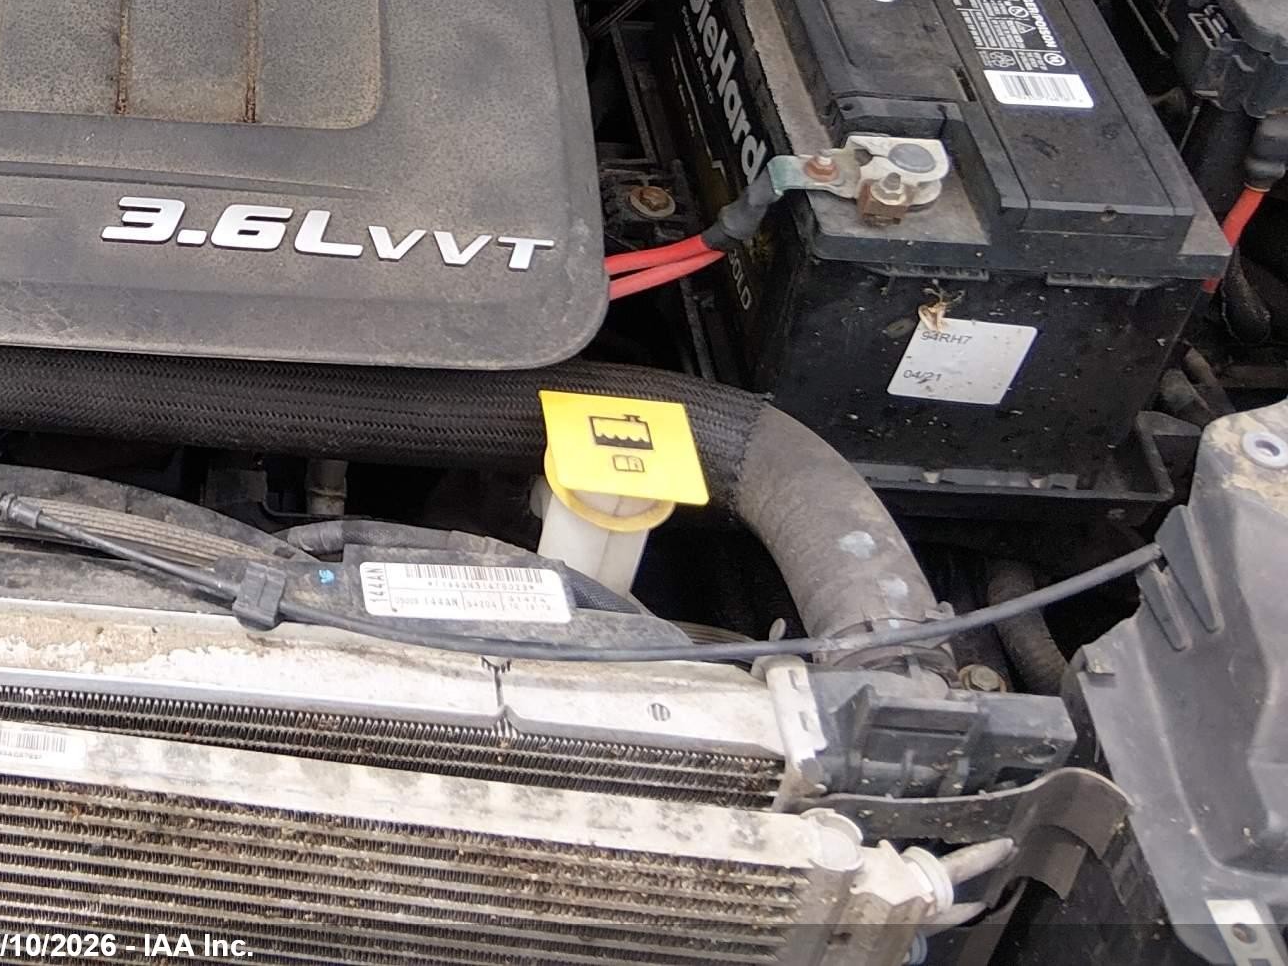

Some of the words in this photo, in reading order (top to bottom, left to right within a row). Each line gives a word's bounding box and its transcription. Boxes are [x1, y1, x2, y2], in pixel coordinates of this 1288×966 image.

[368, 224, 555, 270] VVT
[920, 331, 973, 345] 94RH7
[903, 369, 942, 384] 04/21
